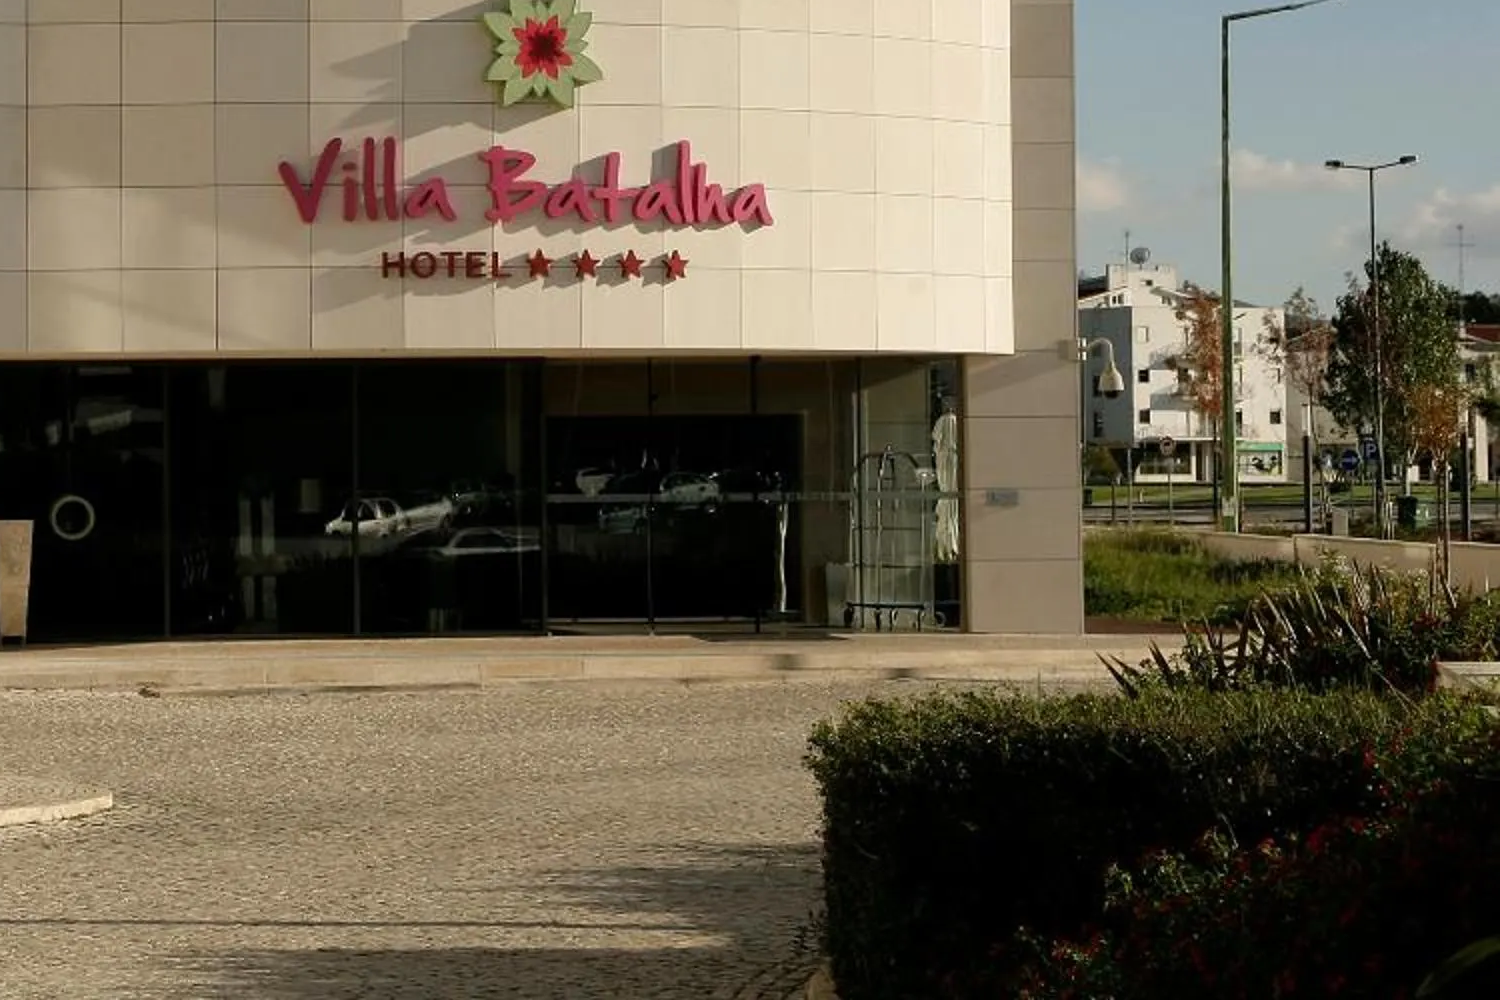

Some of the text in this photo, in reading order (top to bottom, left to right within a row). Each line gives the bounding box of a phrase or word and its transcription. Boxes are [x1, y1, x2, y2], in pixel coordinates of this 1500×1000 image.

[278, 137, 774, 227] Villa Batalha
[381, 250, 513, 280] HOTEL
[1365, 443, 1377, 458] P
